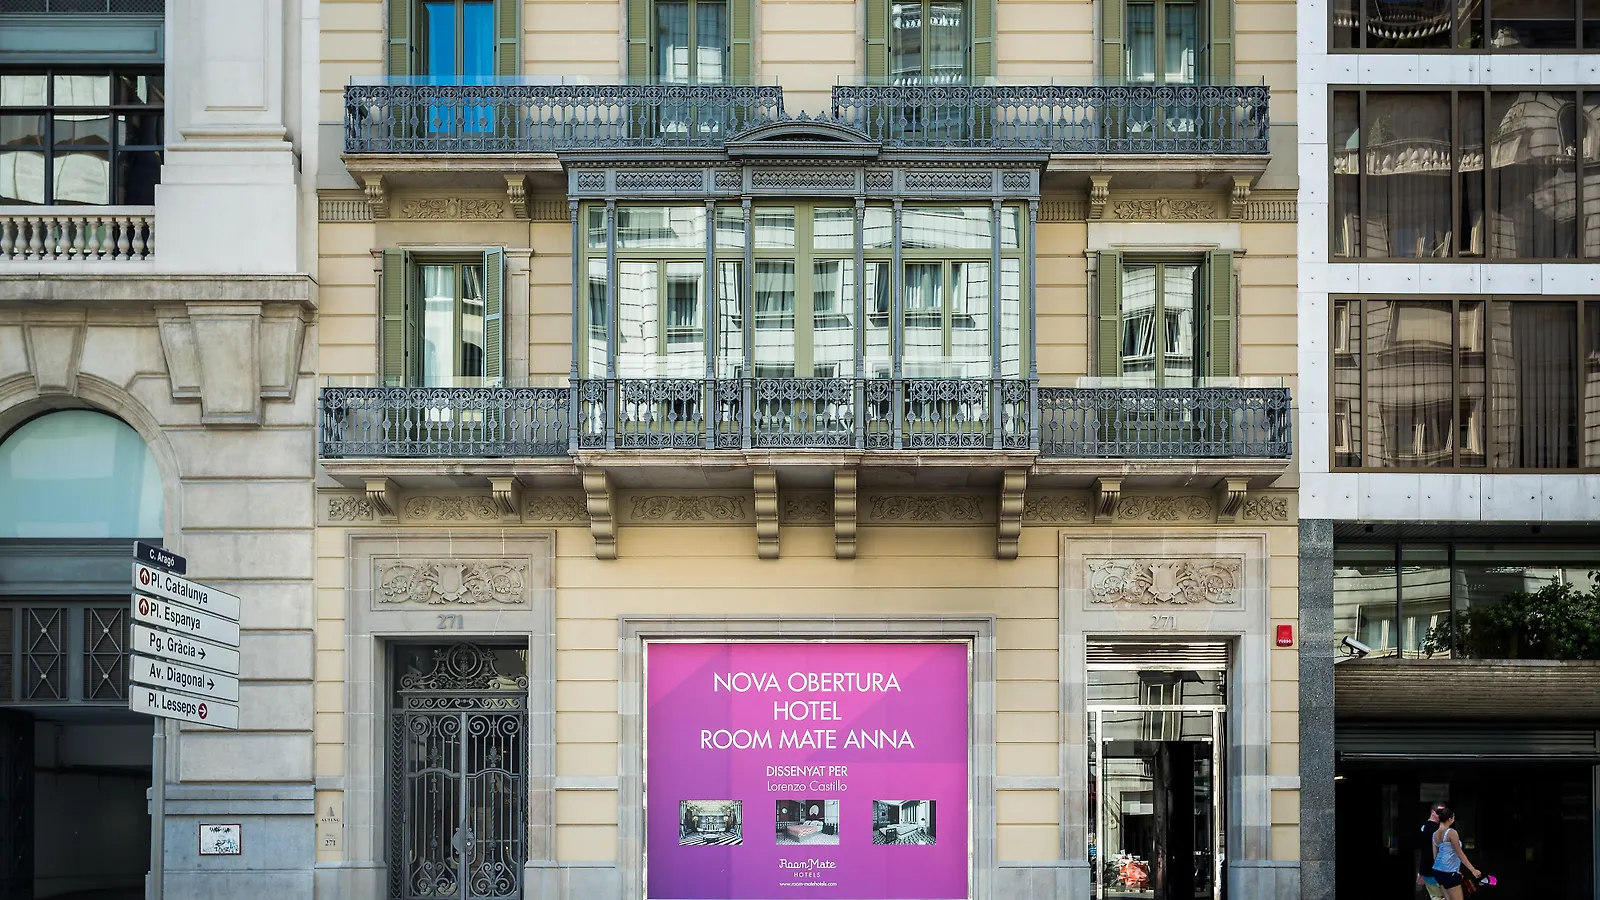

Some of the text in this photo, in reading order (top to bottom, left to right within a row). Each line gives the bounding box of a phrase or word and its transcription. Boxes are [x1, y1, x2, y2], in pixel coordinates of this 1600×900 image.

[149, 549, 175, 568] C. Aragó
[151, 572, 208, 604] Pl. Catalunya
[150, 602, 201, 631] Pl. Espanya
[437, 614, 464, 630] 271
[1150, 615, 1178, 630] 271
[149, 632, 196, 658] Pg. Gràcia
[149, 663, 205, 689] Av. Diagonal
[713, 672, 901, 693] NOVA OBERTURA
[148, 692, 196, 716] Pl. Lesseps
[773, 701, 842, 721] HOTEL
[701, 729, 915, 749] ROOM MATE ANNA
[766, 766, 848, 777] DISSENYAT PER
[767, 781, 847, 792] Lorenzo Castillo
[325, 839, 336, 847] 271
